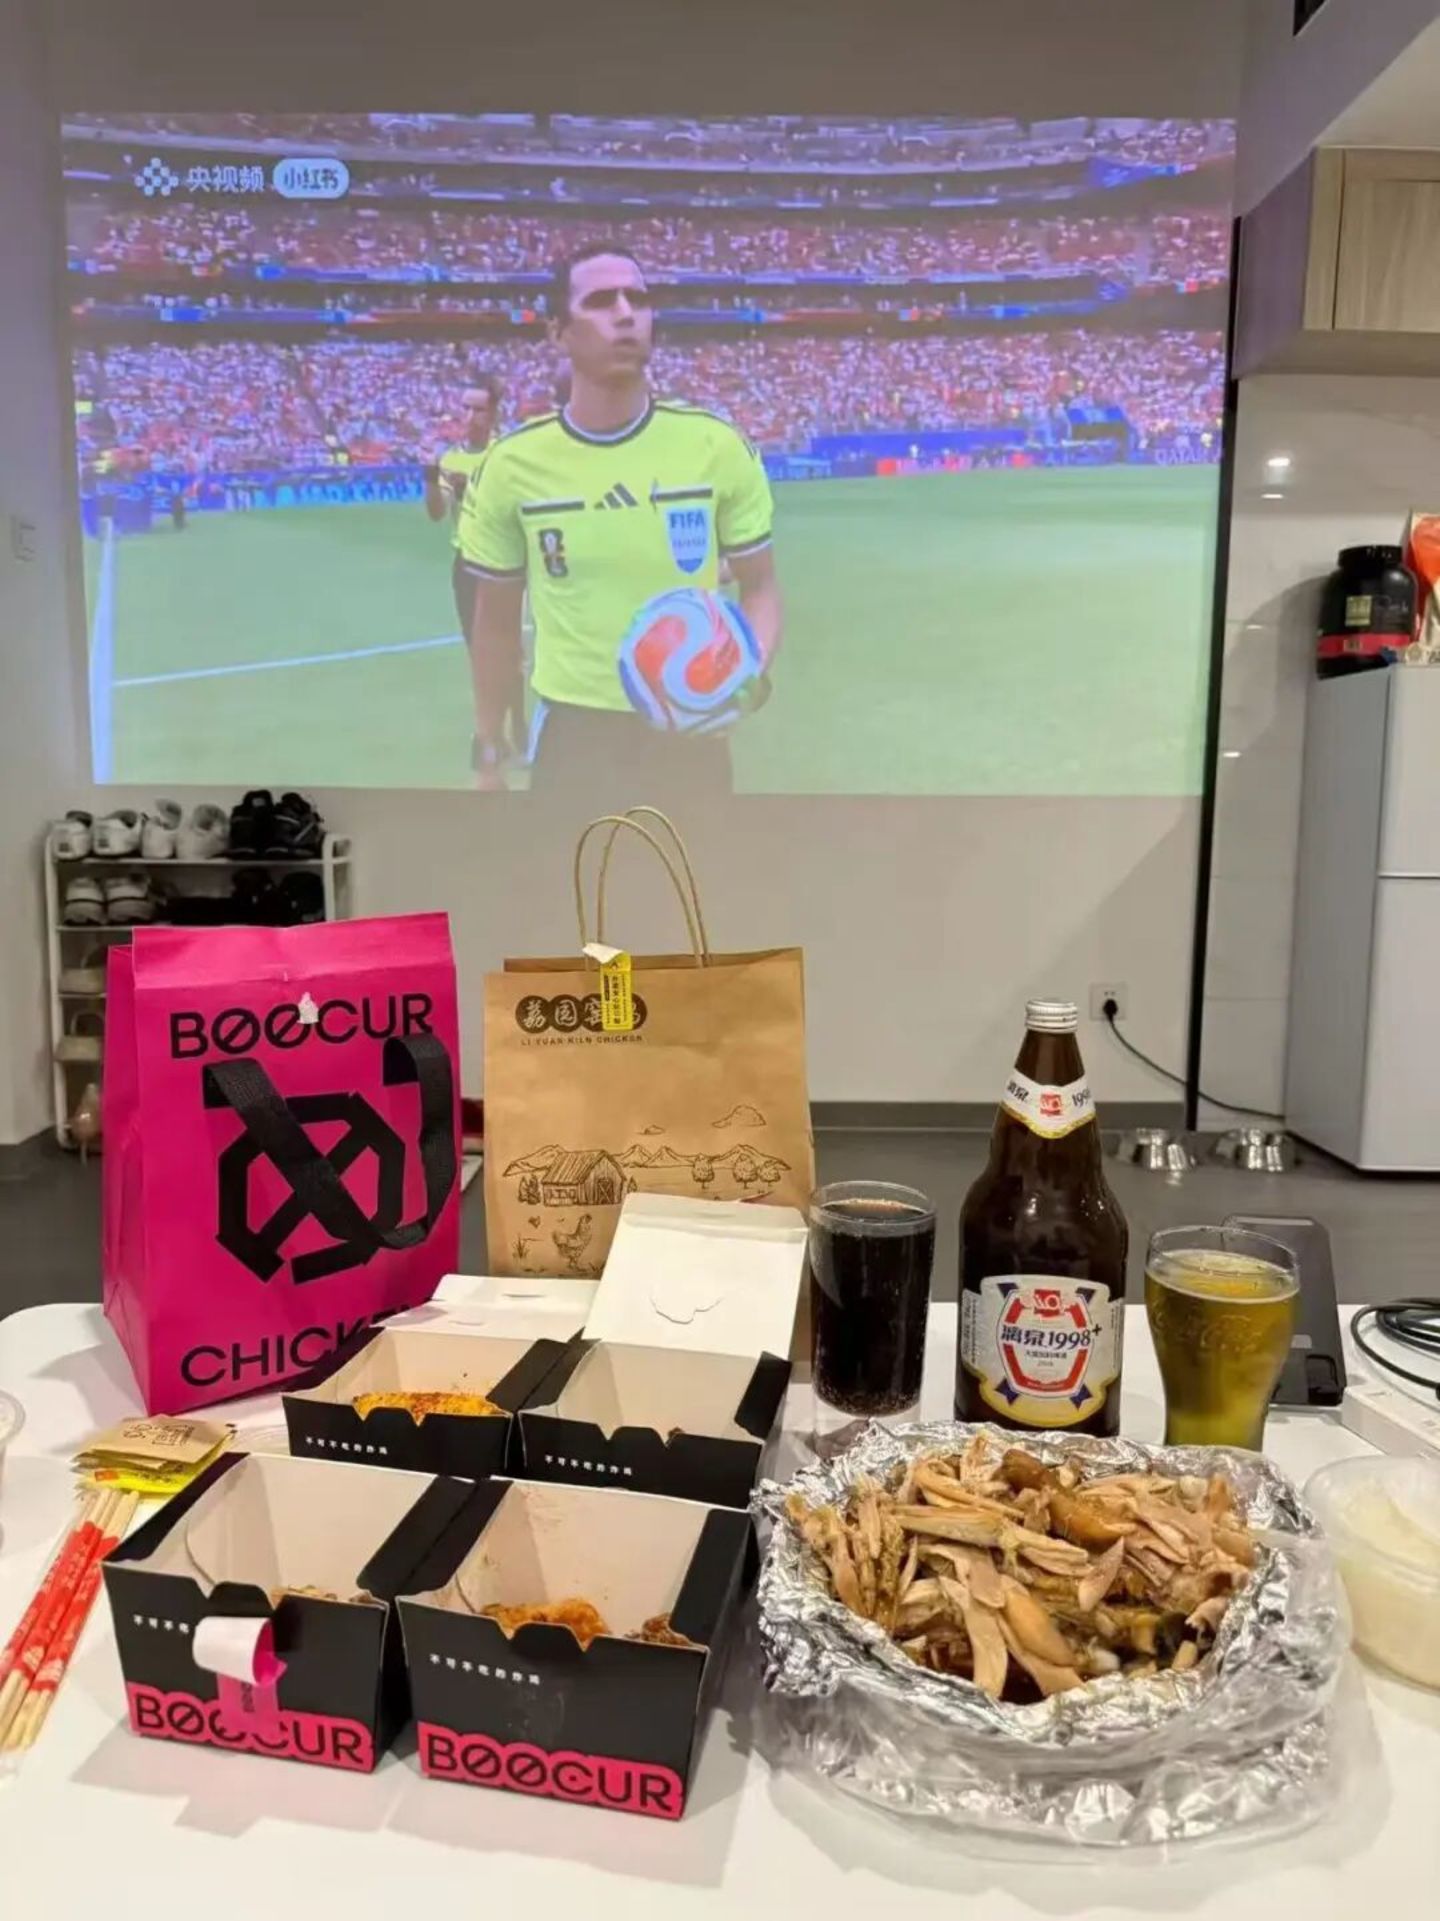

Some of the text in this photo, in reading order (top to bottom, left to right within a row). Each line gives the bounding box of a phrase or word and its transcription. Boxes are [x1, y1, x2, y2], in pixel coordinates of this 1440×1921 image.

[187, 165, 264, 193] 央视频
[283, 166, 339, 190] 小红书
[670, 510, 705, 528] FIFA
[522, 998, 641, 1029] 荔园窑
